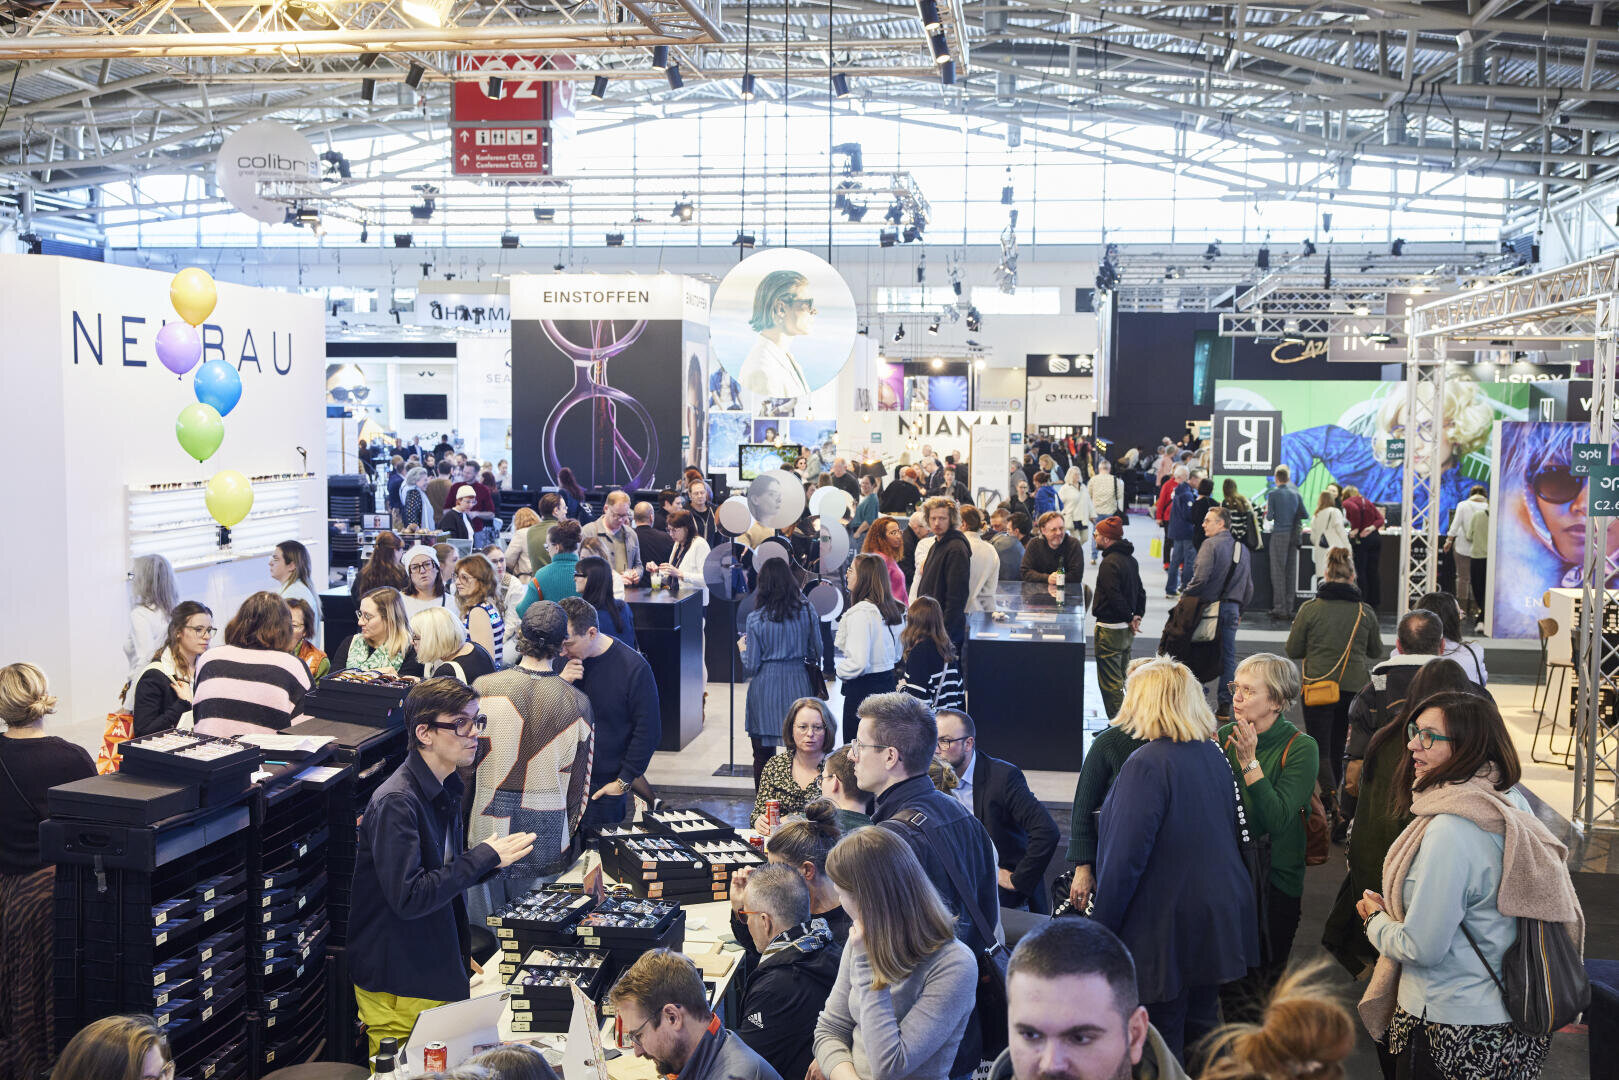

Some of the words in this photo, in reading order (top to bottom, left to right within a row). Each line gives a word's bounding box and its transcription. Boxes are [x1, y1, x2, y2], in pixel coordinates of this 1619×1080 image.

[475, 161, 509, 169] Conference
[543, 291, 649, 303] EINSTOFFEN
[72, 310, 292, 376] NEBAU
[1578, 448, 1602, 461] opti
[1575, 465, 1590, 473] C2.
